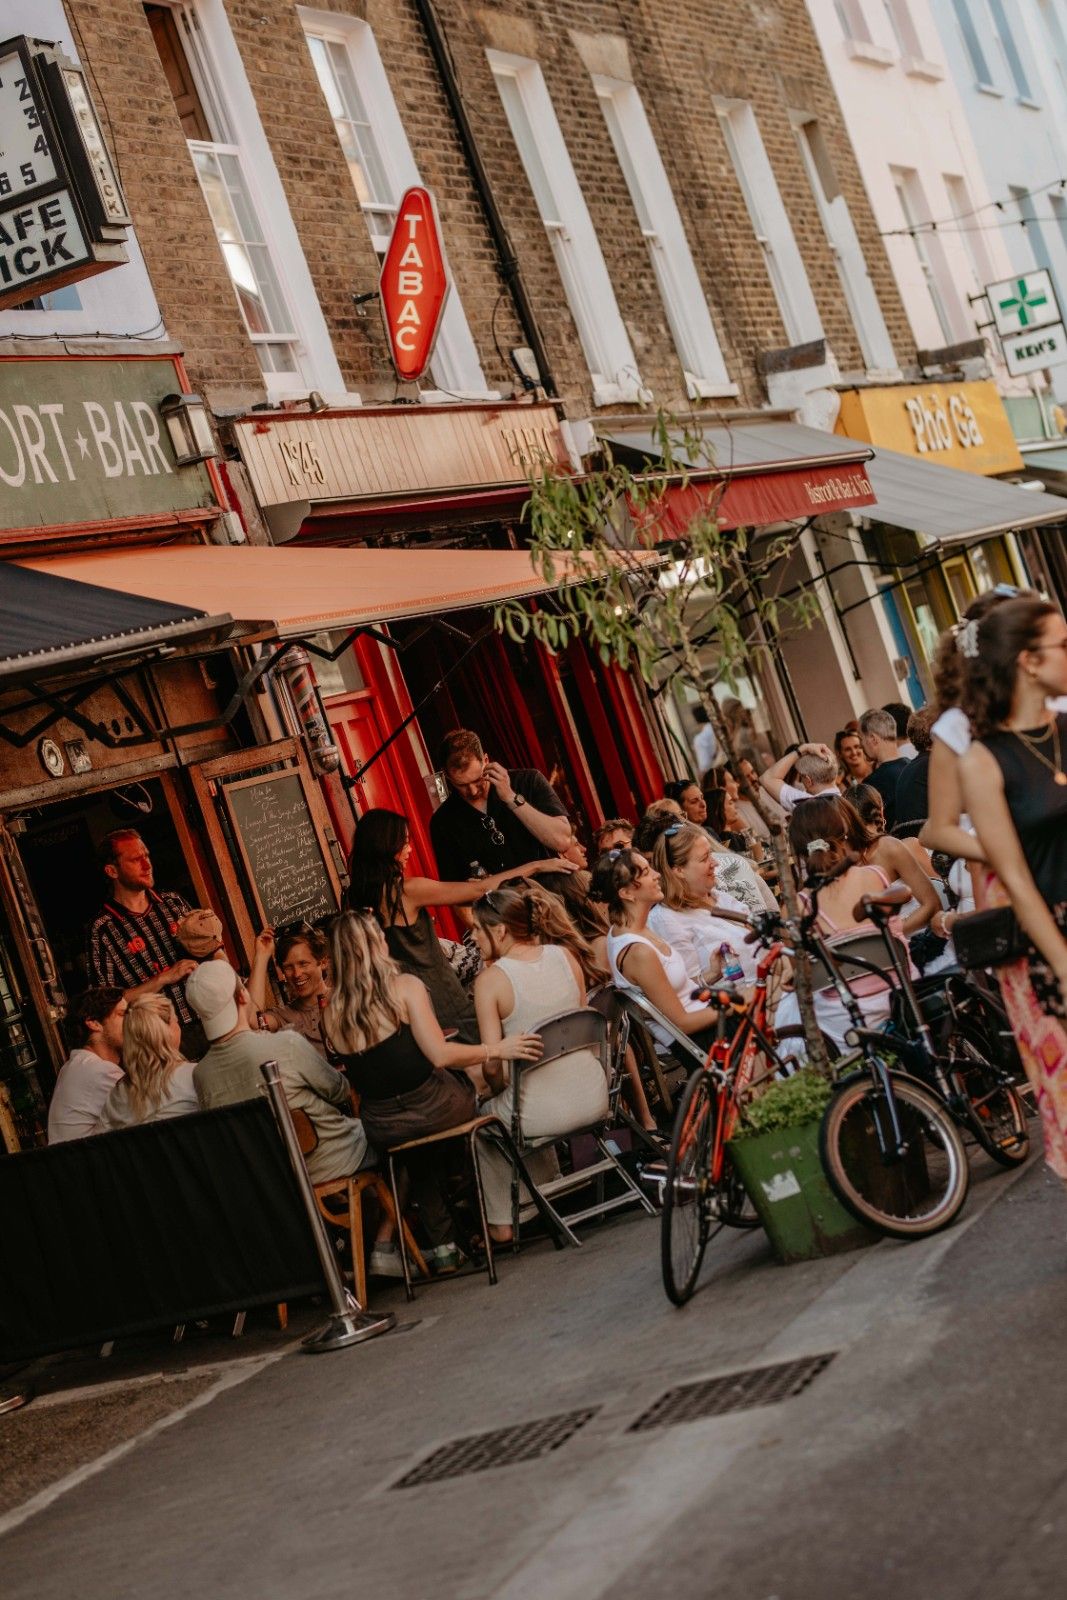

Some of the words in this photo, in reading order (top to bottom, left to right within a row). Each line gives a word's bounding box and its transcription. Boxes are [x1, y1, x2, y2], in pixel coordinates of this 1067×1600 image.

[14, 78, 31, 101] 2
[24, 106, 40, 129] 3
[34, 134, 48, 156] 4
[20, 162, 36, 185] 5
[396, 214, 424, 351] TABAC
[82, 401, 173, 478] BAR
